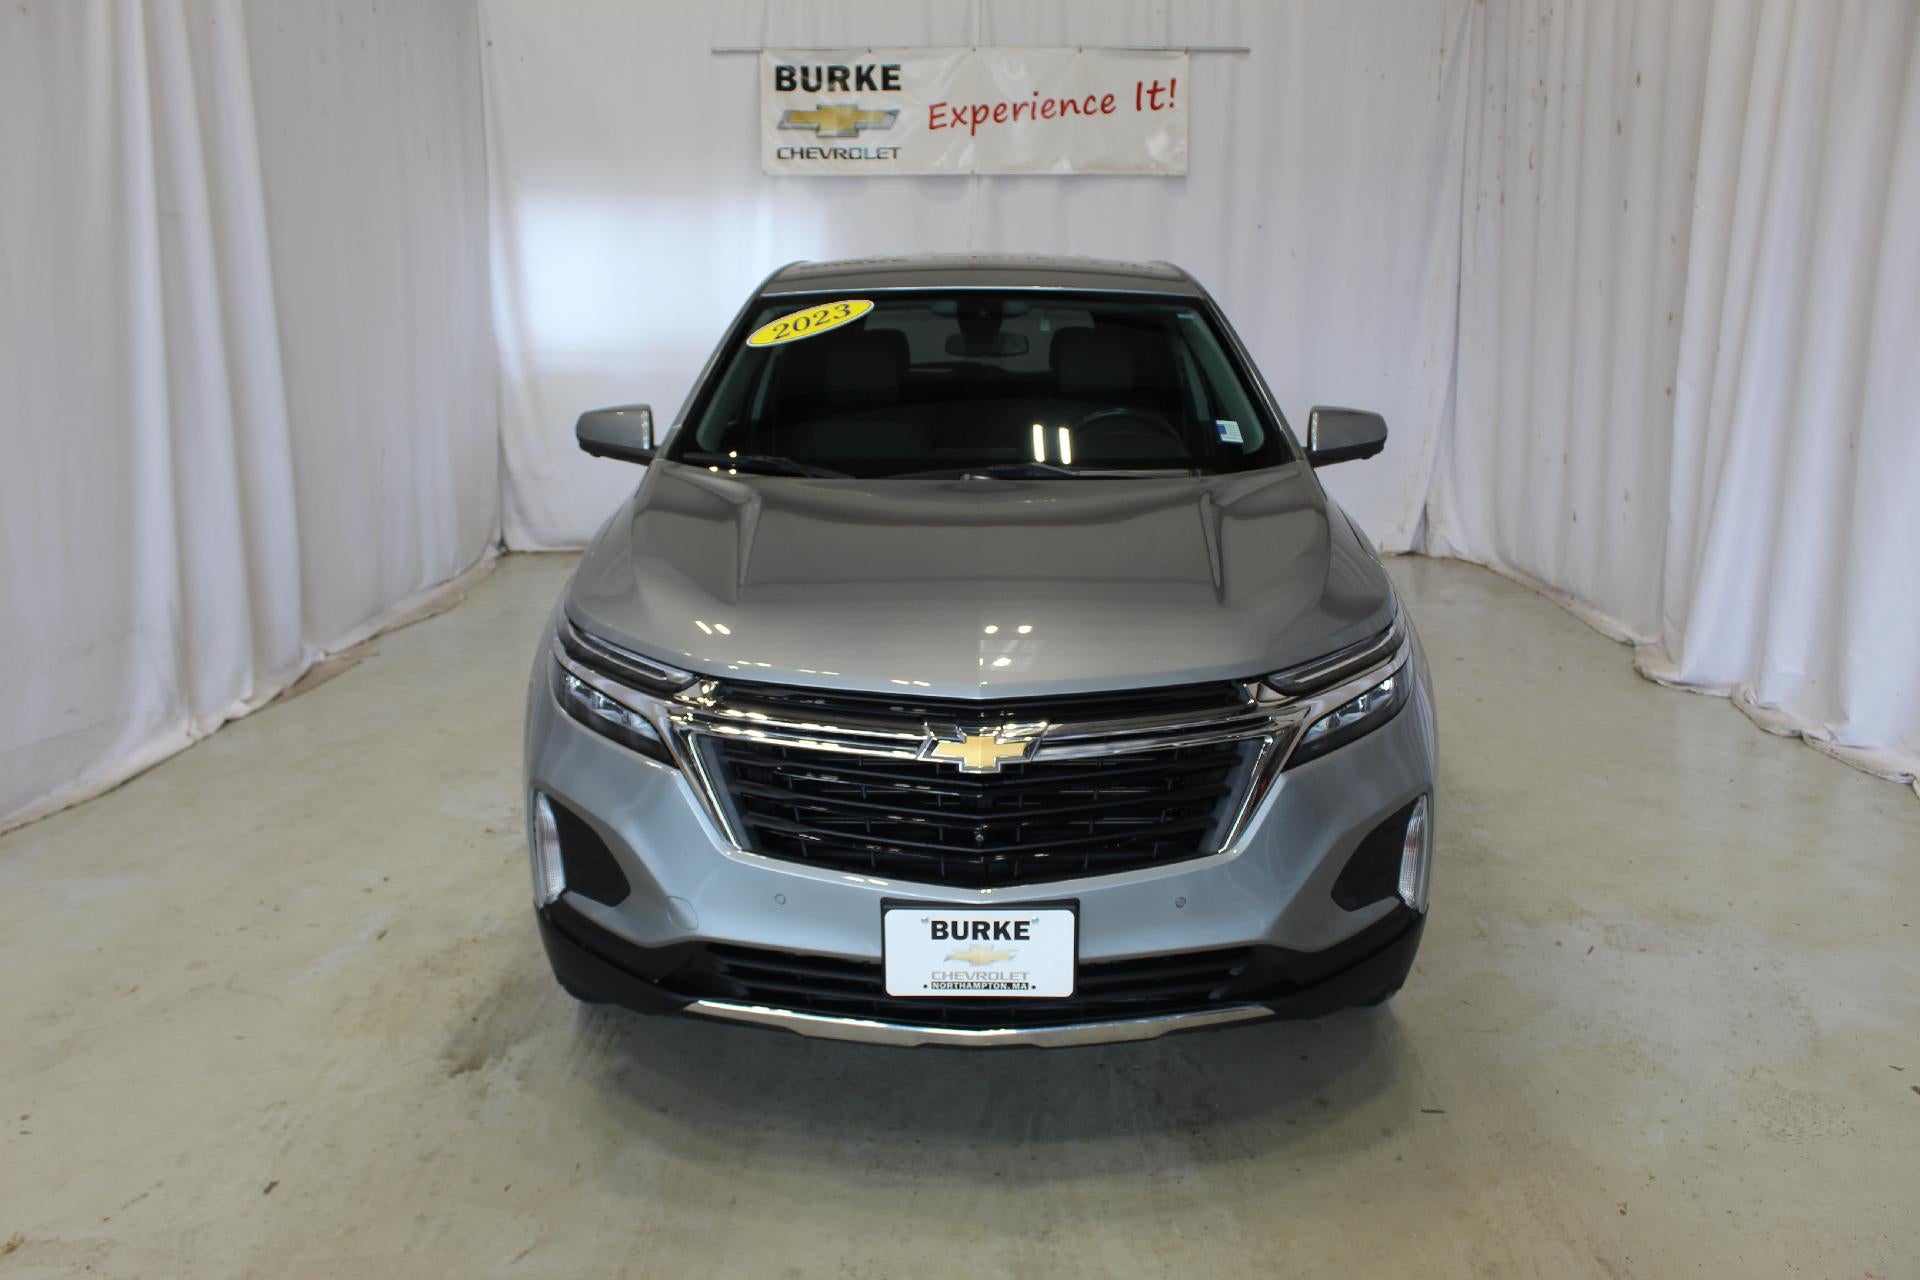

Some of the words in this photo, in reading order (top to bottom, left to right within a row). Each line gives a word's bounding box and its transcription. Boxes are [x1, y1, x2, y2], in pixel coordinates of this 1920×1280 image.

[775, 64, 901, 92] BURKE
[928, 91, 1117, 136] Experience
[1134, 78, 1178, 112] It!
[777, 146, 901, 160] CHEVROLET
[772, 303, 851, 340] 2023
[931, 920, 1030, 940] BURKE
[931, 971, 1030, 980] CHEVROLET
[1012, 982, 1028, 990] MA
